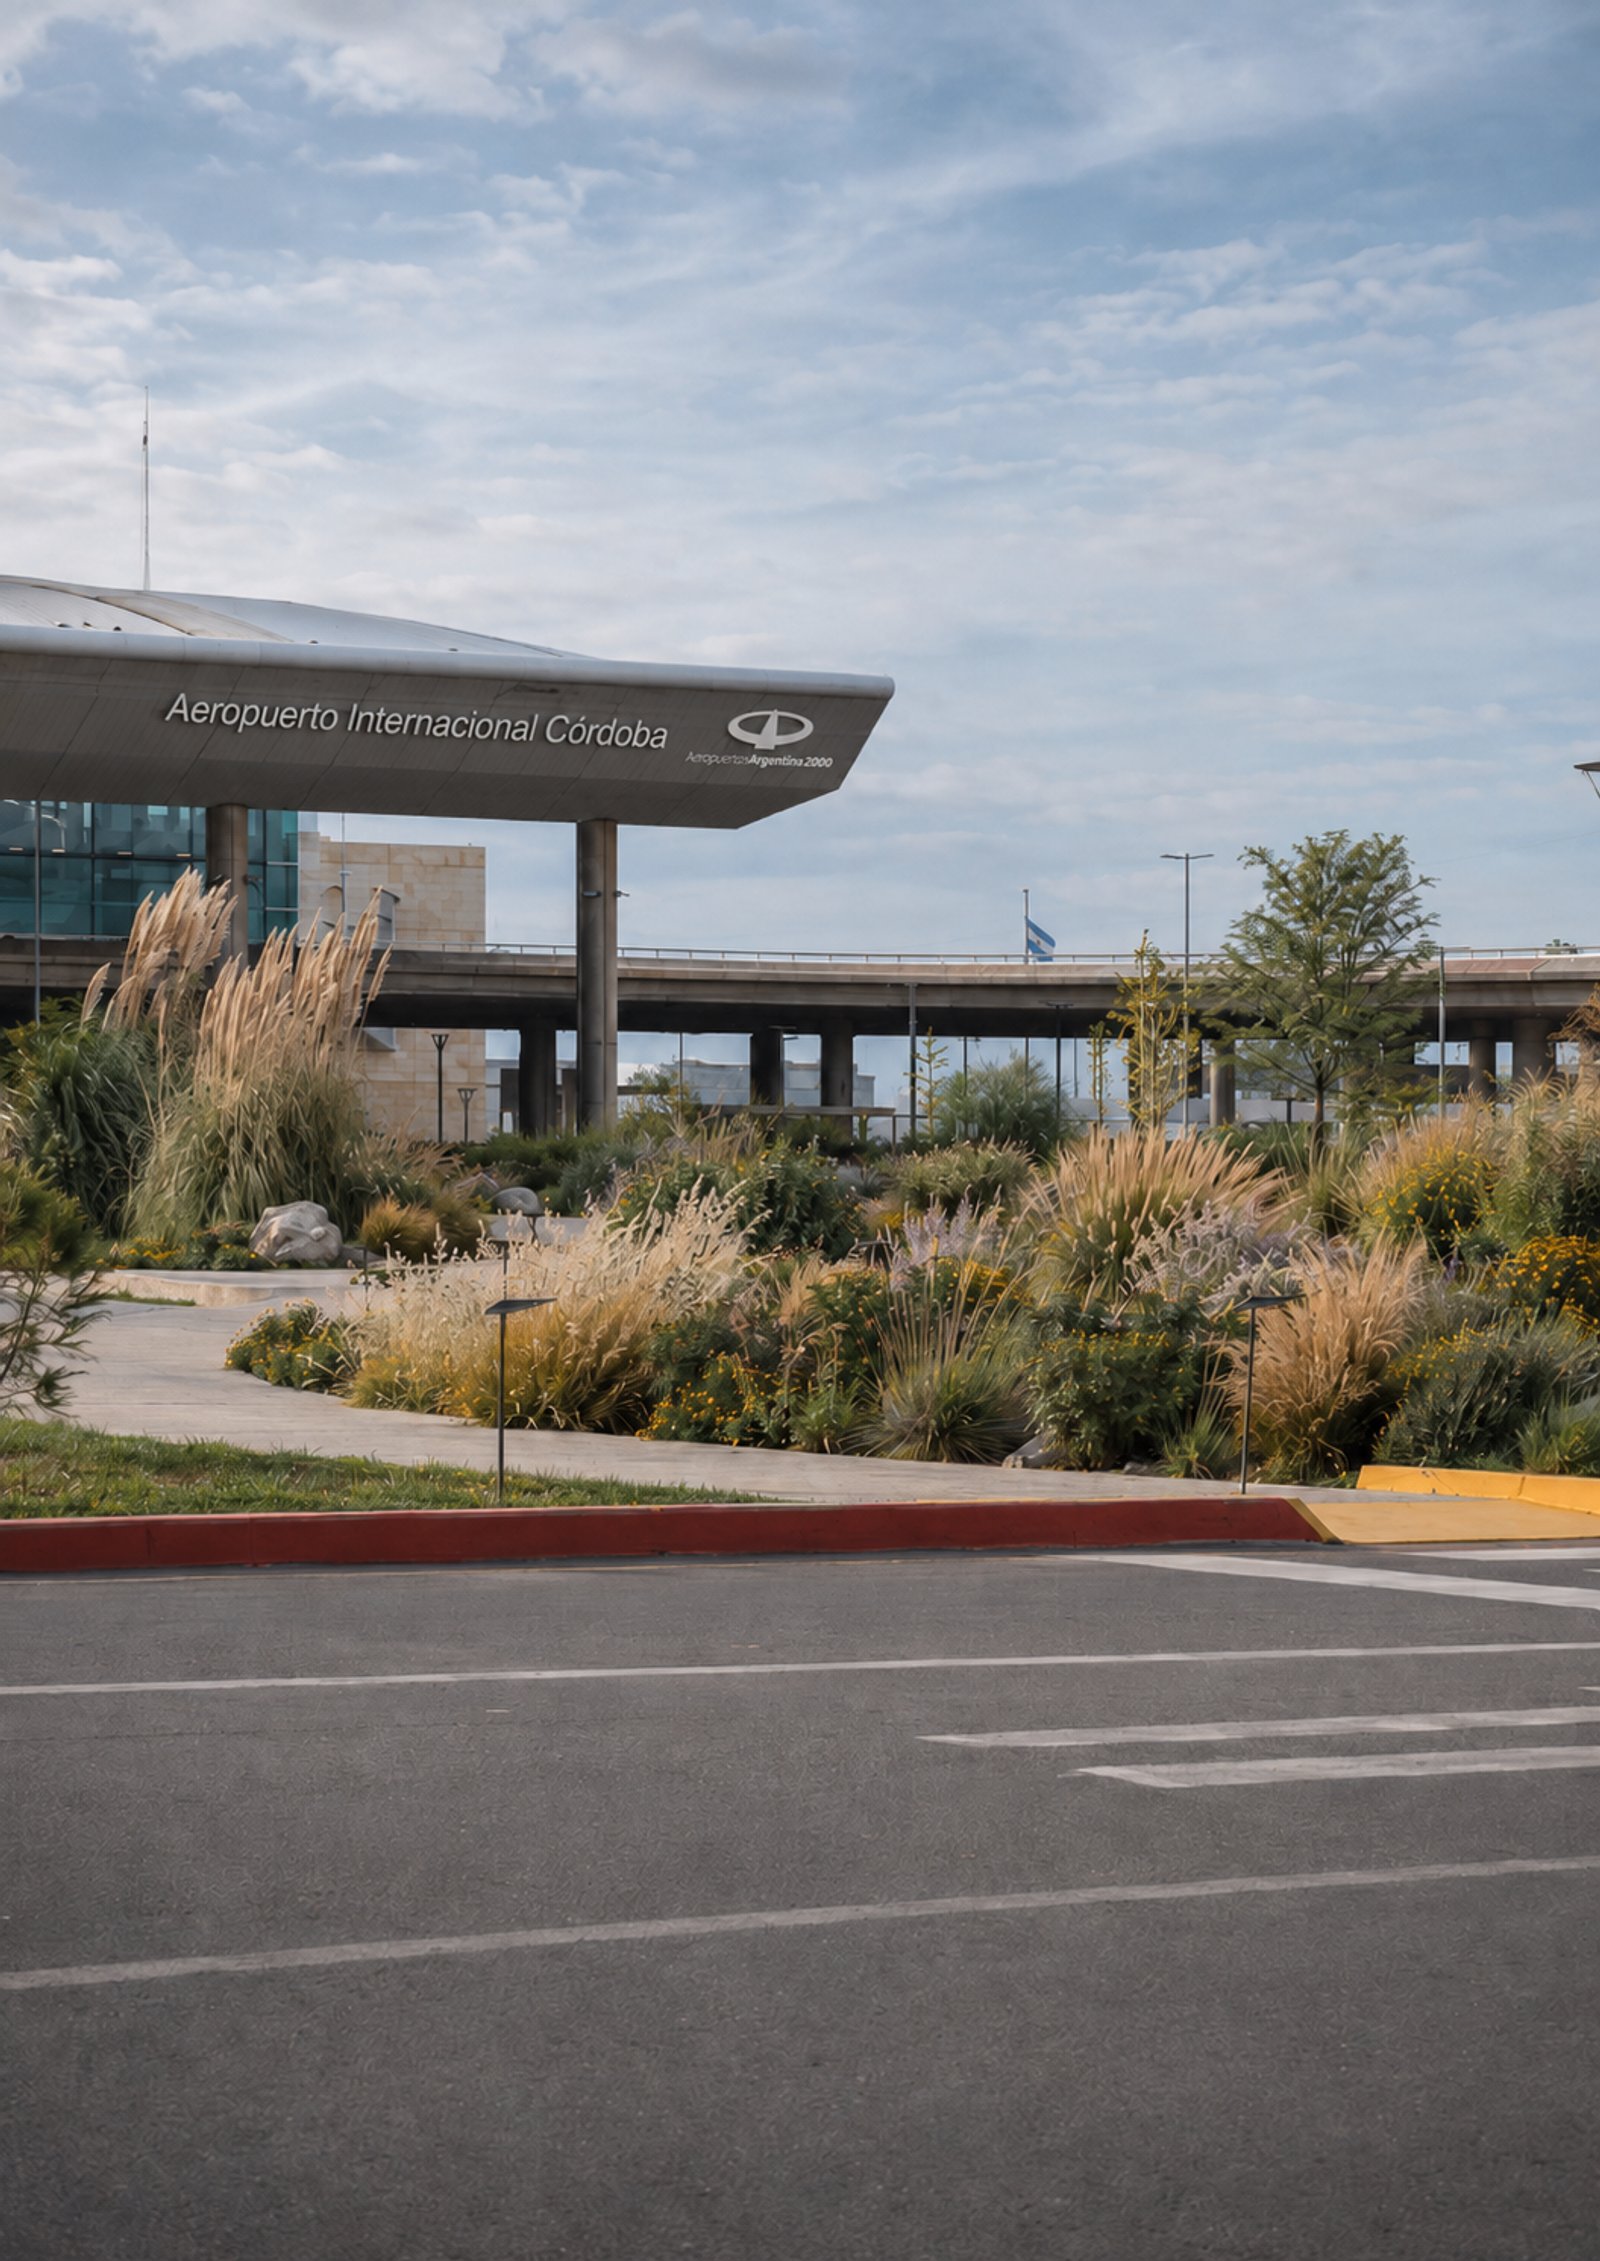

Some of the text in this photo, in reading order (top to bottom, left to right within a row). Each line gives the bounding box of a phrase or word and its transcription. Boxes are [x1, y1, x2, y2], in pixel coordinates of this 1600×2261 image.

[166, 692, 669, 749] Aeropuerto Internacional Córdoba
[804, 756, 834, 768] 2000
